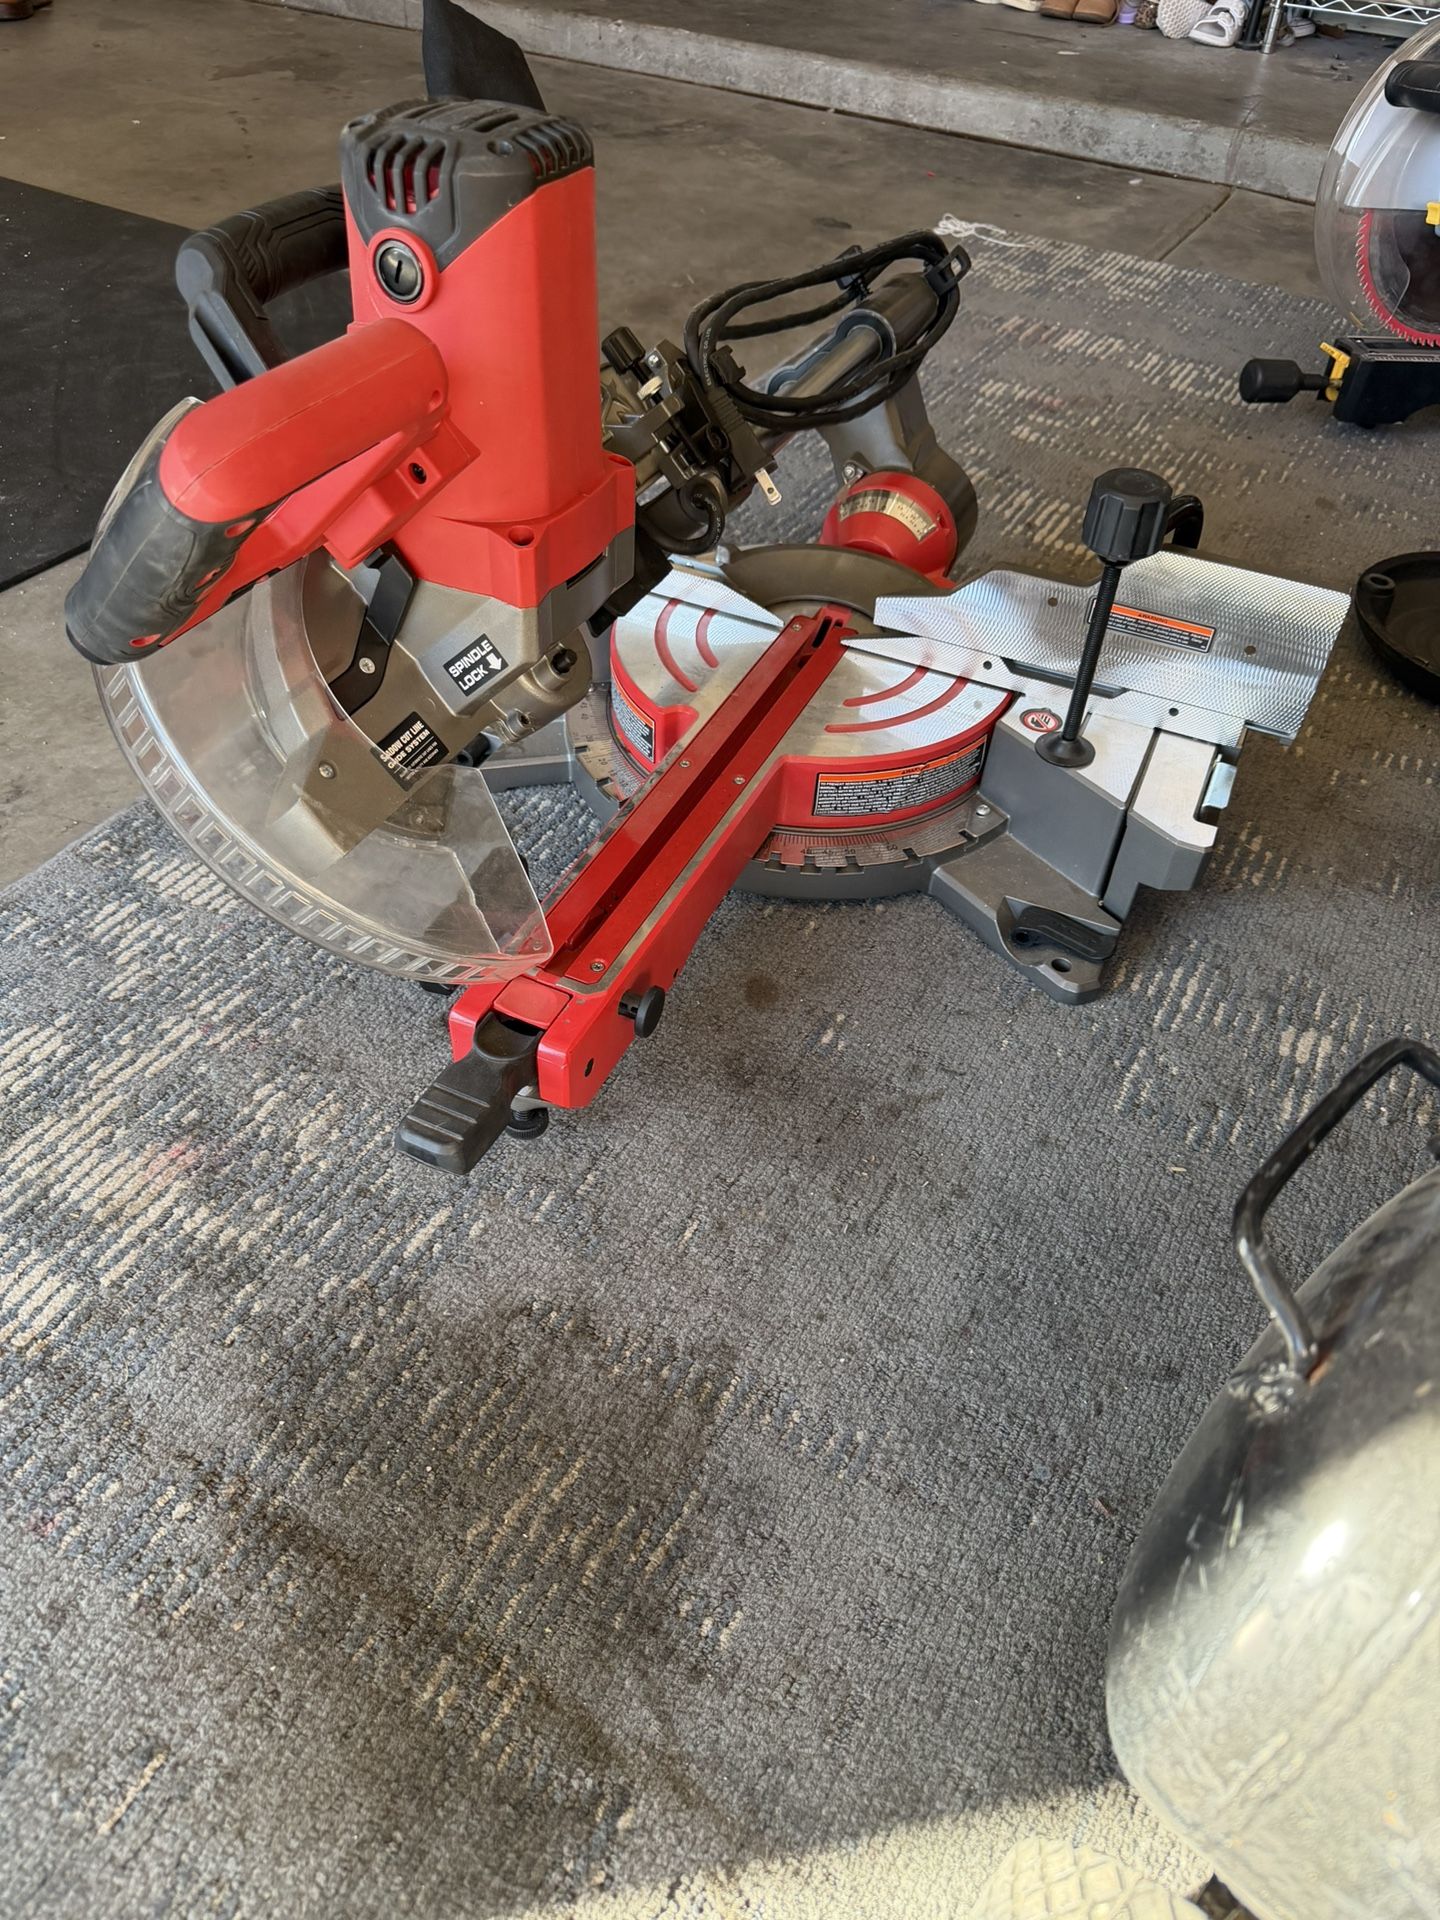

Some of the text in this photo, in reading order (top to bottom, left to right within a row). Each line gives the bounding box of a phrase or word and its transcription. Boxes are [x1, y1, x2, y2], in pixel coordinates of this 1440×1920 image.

[448, 639, 494, 678] SPINDLE
[458, 664, 489, 691] LOCK
[400, 730, 413, 744] CUT
[409, 720, 425, 736] LINE
[405, 729, 431, 753] SYSTEM
